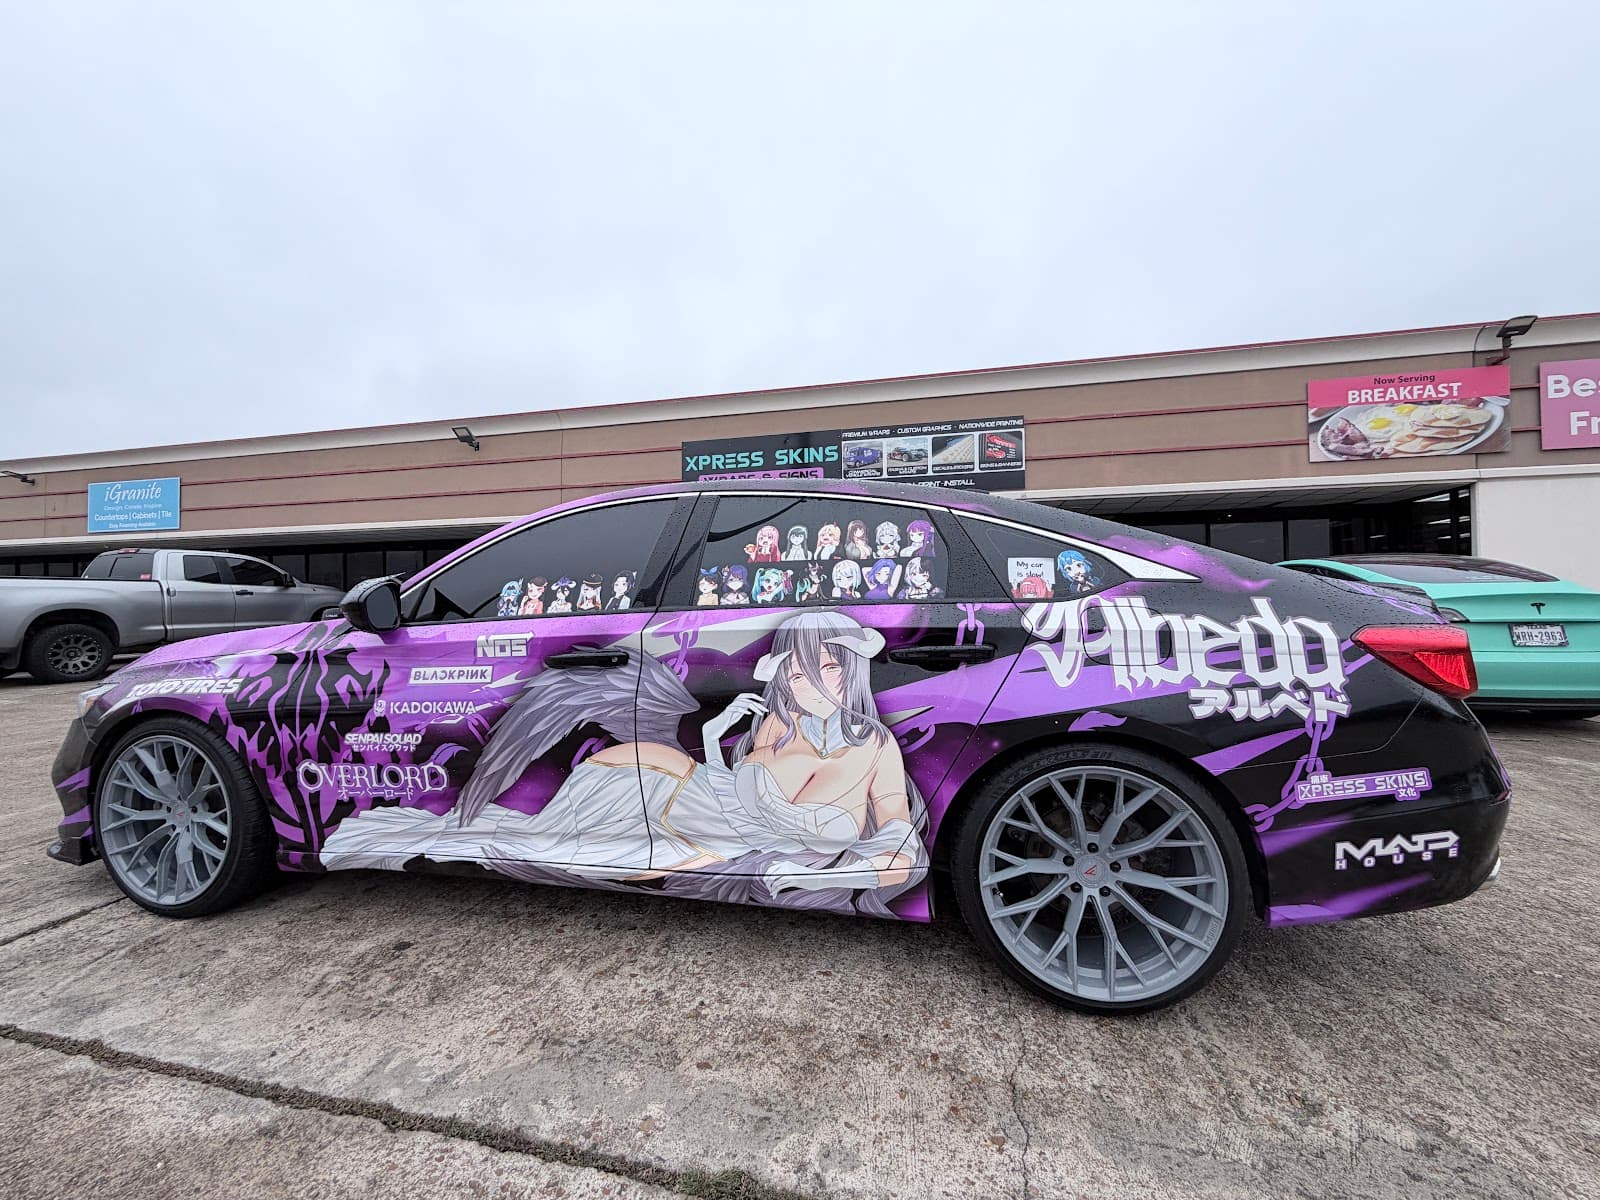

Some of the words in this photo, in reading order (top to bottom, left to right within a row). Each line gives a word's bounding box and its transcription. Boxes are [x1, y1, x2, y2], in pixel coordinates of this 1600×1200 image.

[1373, 376, 1396, 385] Now
[1397, 373, 1436, 384] Serving
[1347, 382, 1463, 404] BREAKFAST
[897, 426, 922, 434] CUSTOM
[922, 424, 952, 432] GRAPHICS
[958, 421, 996, 429] NATIONWIDE
[996, 419, 1024, 428] PRINTING
[685, 451, 764, 472] XPRESS
[775, 445, 839, 465] SKINS
[779, 470, 819, 480] SIGNS
[104, 482, 162, 504] iGranite
[161, 510, 172, 518] Tile
[1016, 560, 1029, 569] My
[476, 631, 534, 658] NOS
[390, 701, 477, 714] KADOKAWA
[1188, 687, 1350, 722] アルベド
[344, 732, 383, 744] SENPAI
[383, 732, 422, 744] SQUAD
[298, 761, 448, 793] OVERLORD
[1300, 779, 1367, 799] XPRESS
[1374, 771, 1426, 790] SKINS
[1334, 847, 1459, 870] HOUSE
